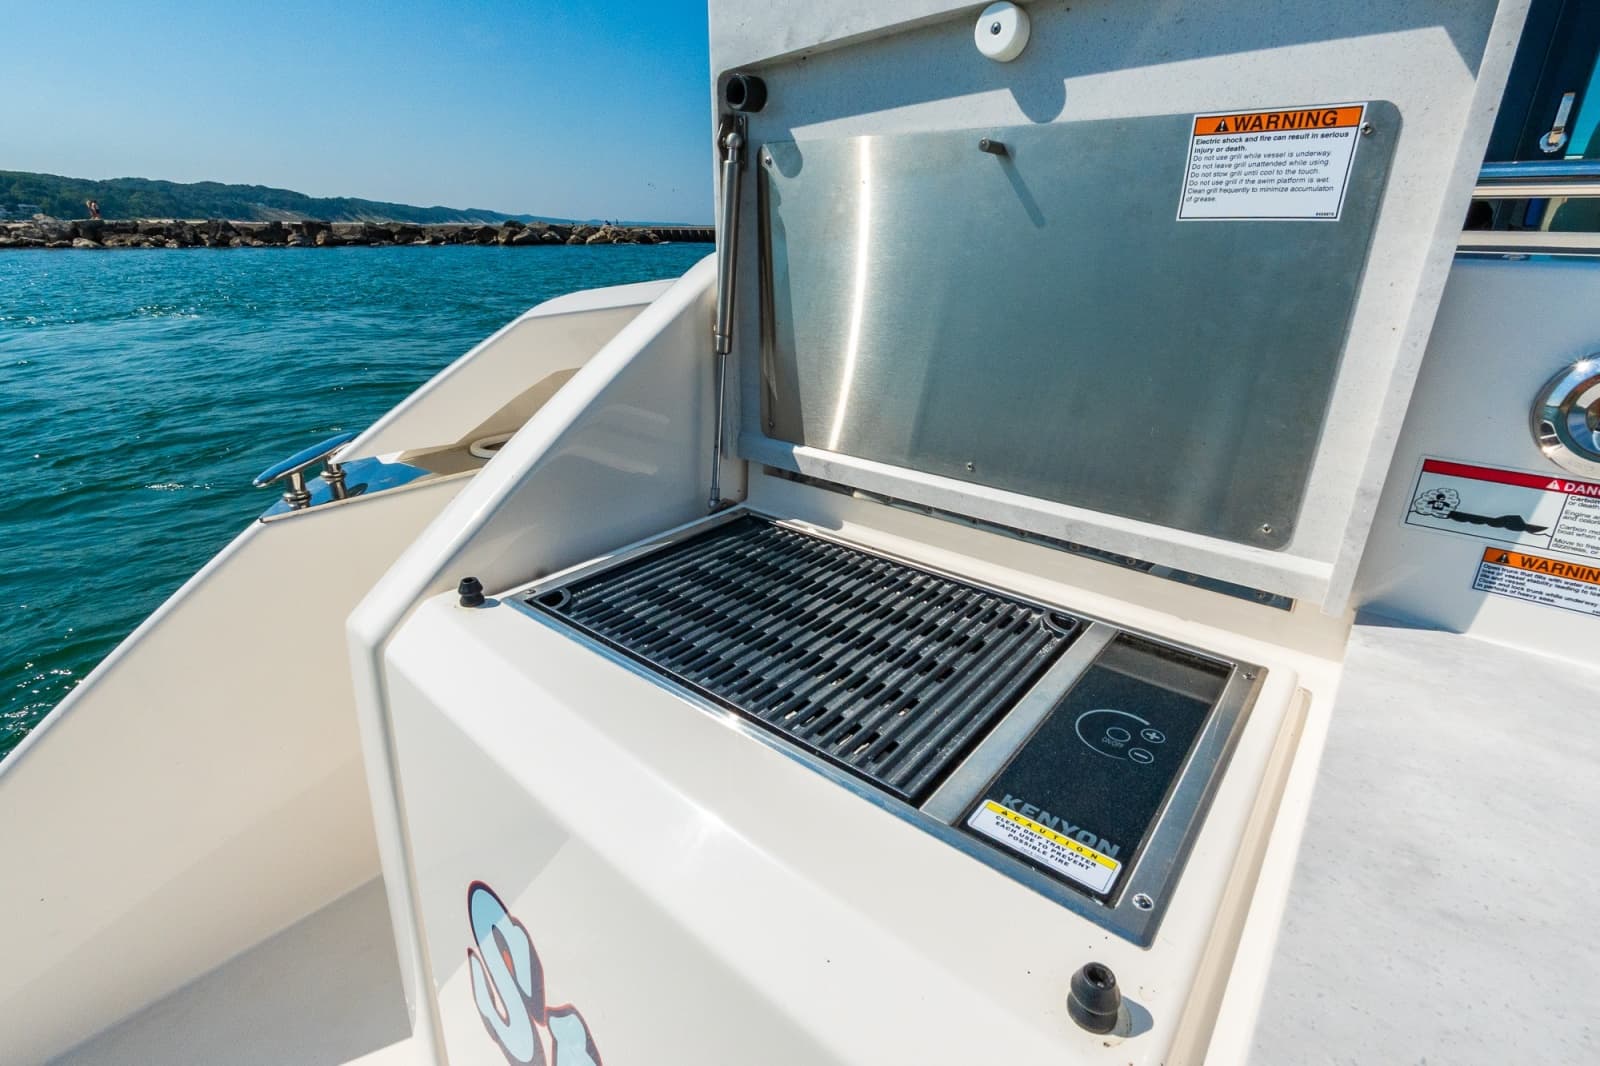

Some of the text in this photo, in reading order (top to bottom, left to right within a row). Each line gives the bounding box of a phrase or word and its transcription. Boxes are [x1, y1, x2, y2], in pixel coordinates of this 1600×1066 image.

[1234, 110, 1338, 132] WARNING
[1229, 170, 1242, 178] grill
[1564, 482, 1600, 497] DAN
[996, 816, 1097, 868] CLEAN DRIP TRAY AFTER
[1002, 794, 1120, 858] KENYON
[1014, 816, 1098, 859] CAUTION
[996, 821, 1016, 834] EACH
[1019, 833, 1035, 843] USE
[1050, 849, 1090, 870] PREVENT
[1008, 834, 1048, 855] POSSIBLE
[1050, 855, 1069, 866] FIRE
